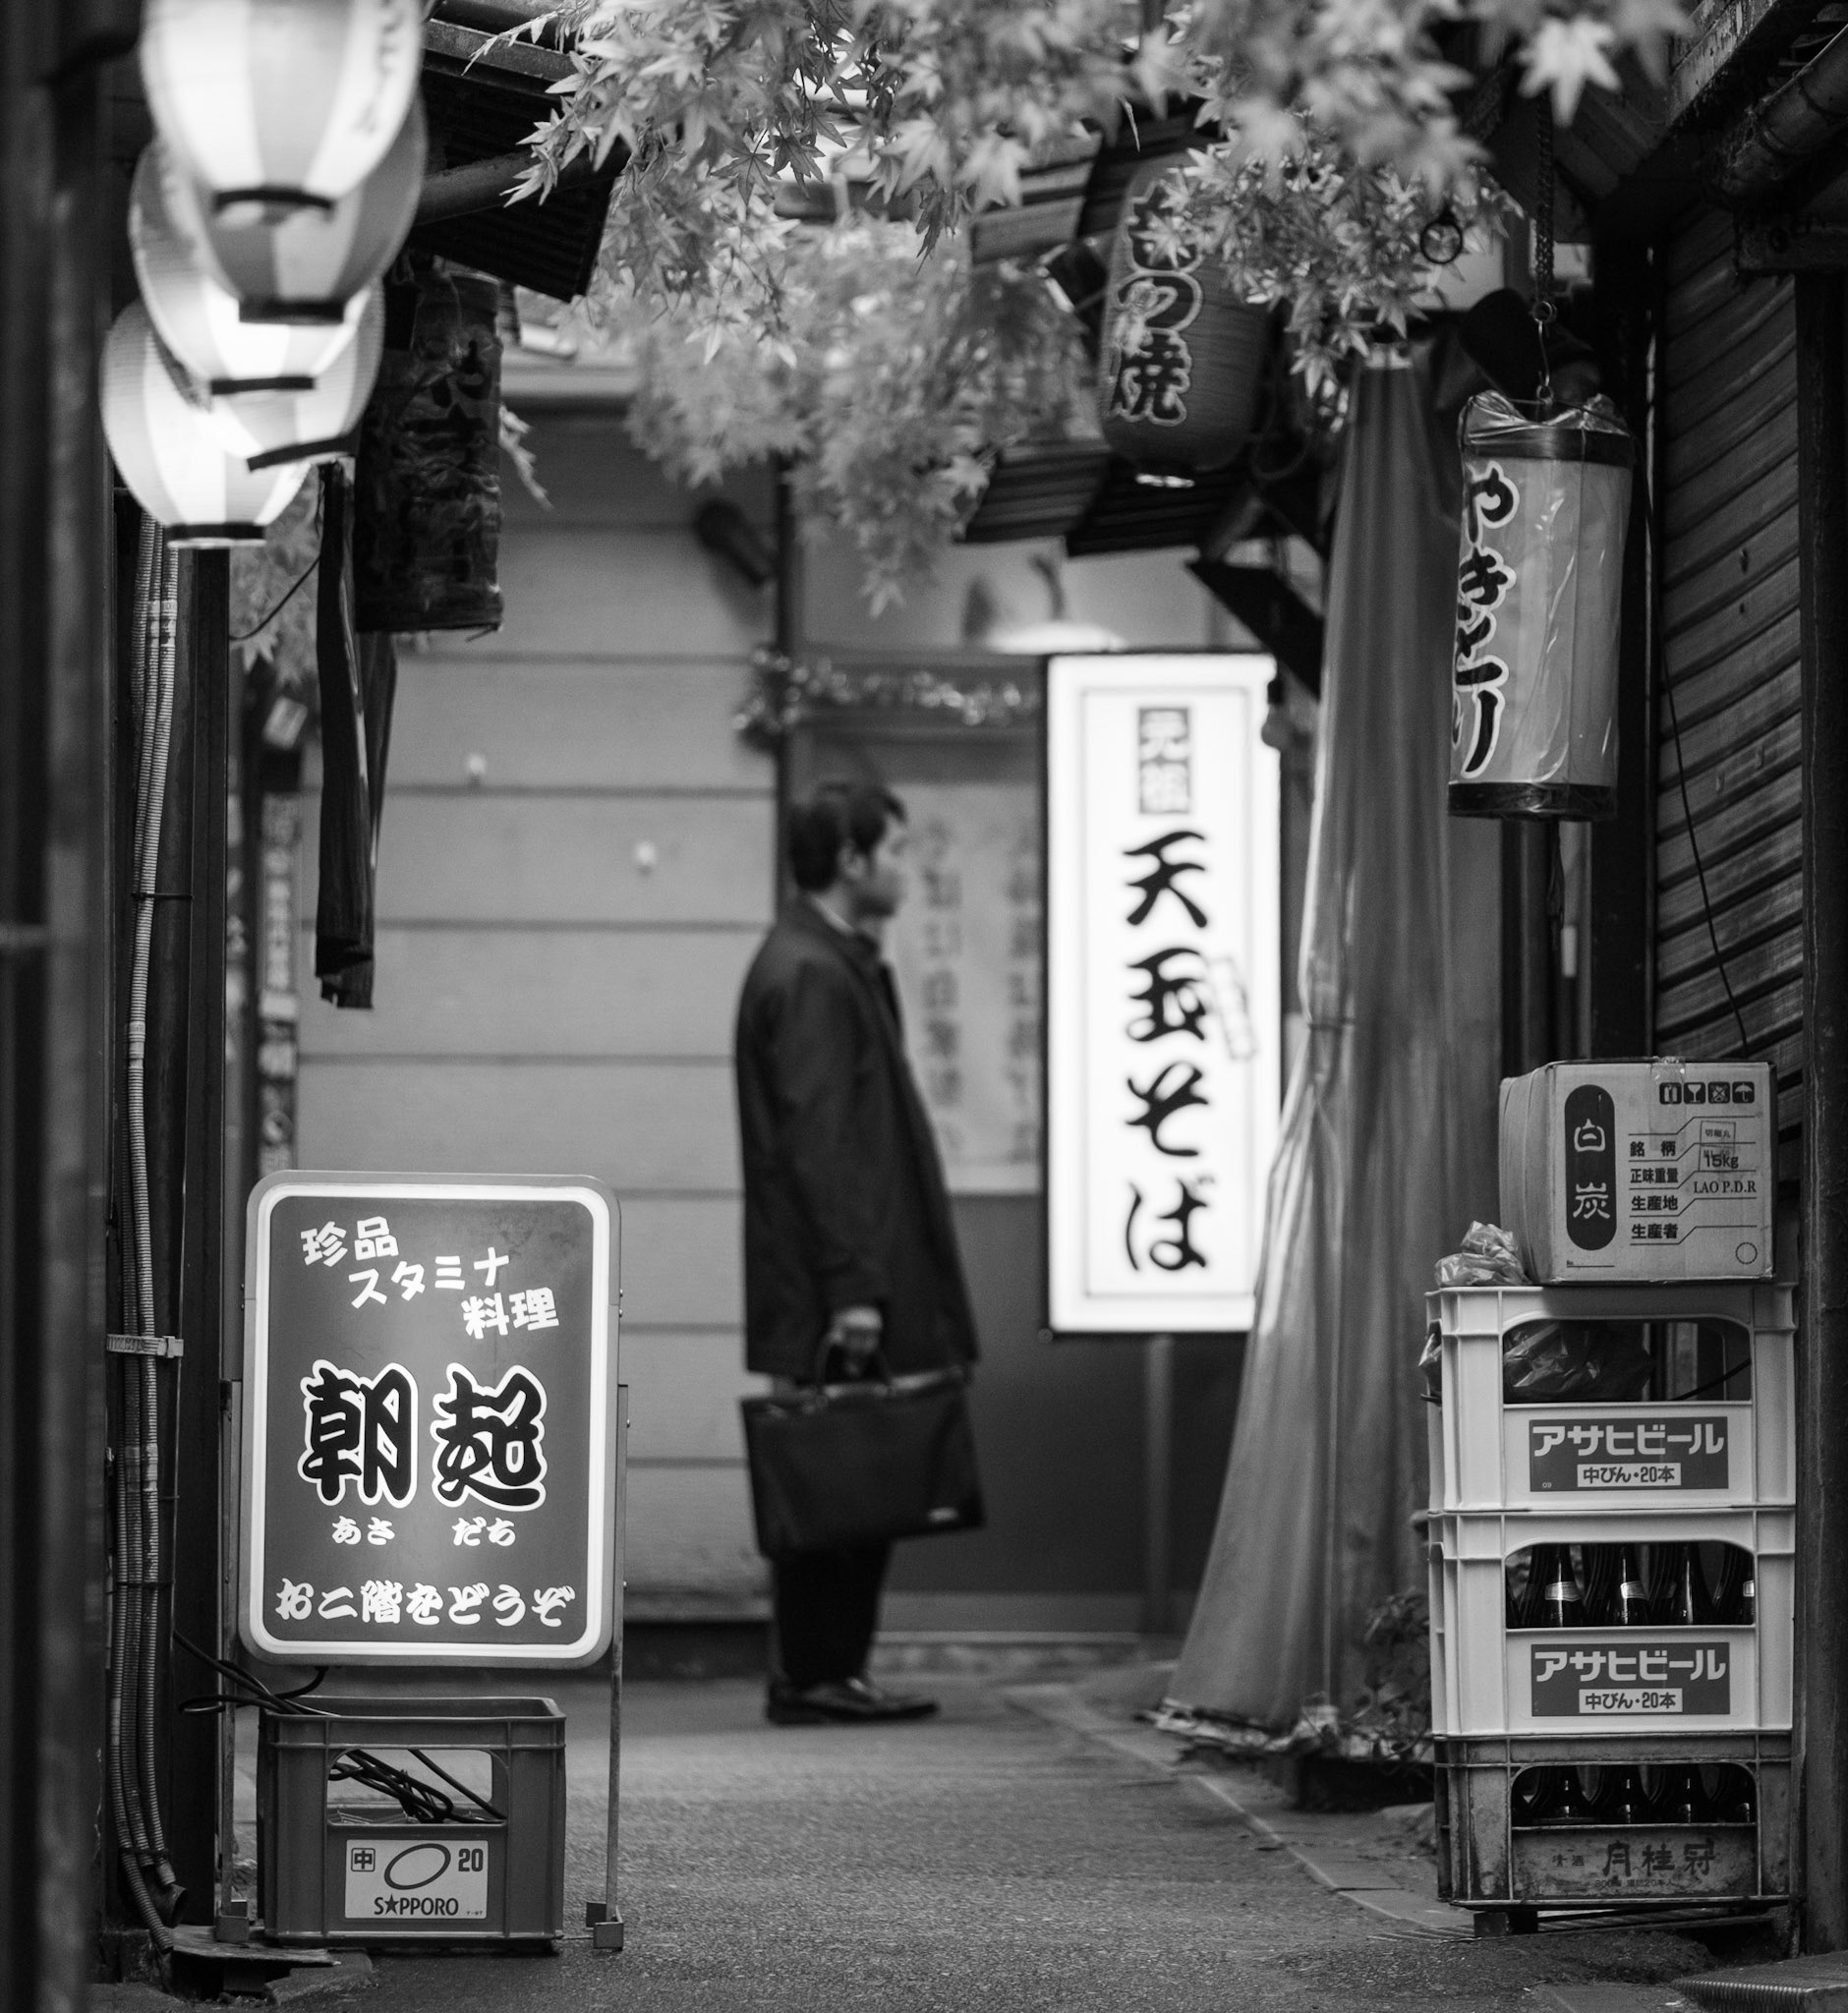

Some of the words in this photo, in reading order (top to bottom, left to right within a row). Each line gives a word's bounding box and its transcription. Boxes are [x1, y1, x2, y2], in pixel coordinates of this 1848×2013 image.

[1573, 1118, 1610, 1220] 白炭
[1630, 1168, 1679, 1184] 正味重量
[1631, 1194, 1679, 1211] 生産地
[1694, 1180, 1720, 1193] LAO
[300, 1215, 399, 1267] 珍品
[1631, 1223, 1679, 1239] 生産者
[348, 1246, 510, 1308] スタミナ
[461, 1287, 560, 1340] 料理
[1531, 1423, 1725, 1457] アサヒビール
[331, 1516, 396, 1546] あさ
[451, 1517, 516, 1547] だち
[274, 1578, 576, 1628] お二階をどうぞ
[1533, 1648, 1727, 1683] アサヒビール
[354, 1849, 373, 1870] 中
[458, 1848, 485, 1872] 20
[1602, 1839, 1716, 1876] 月桂冠
